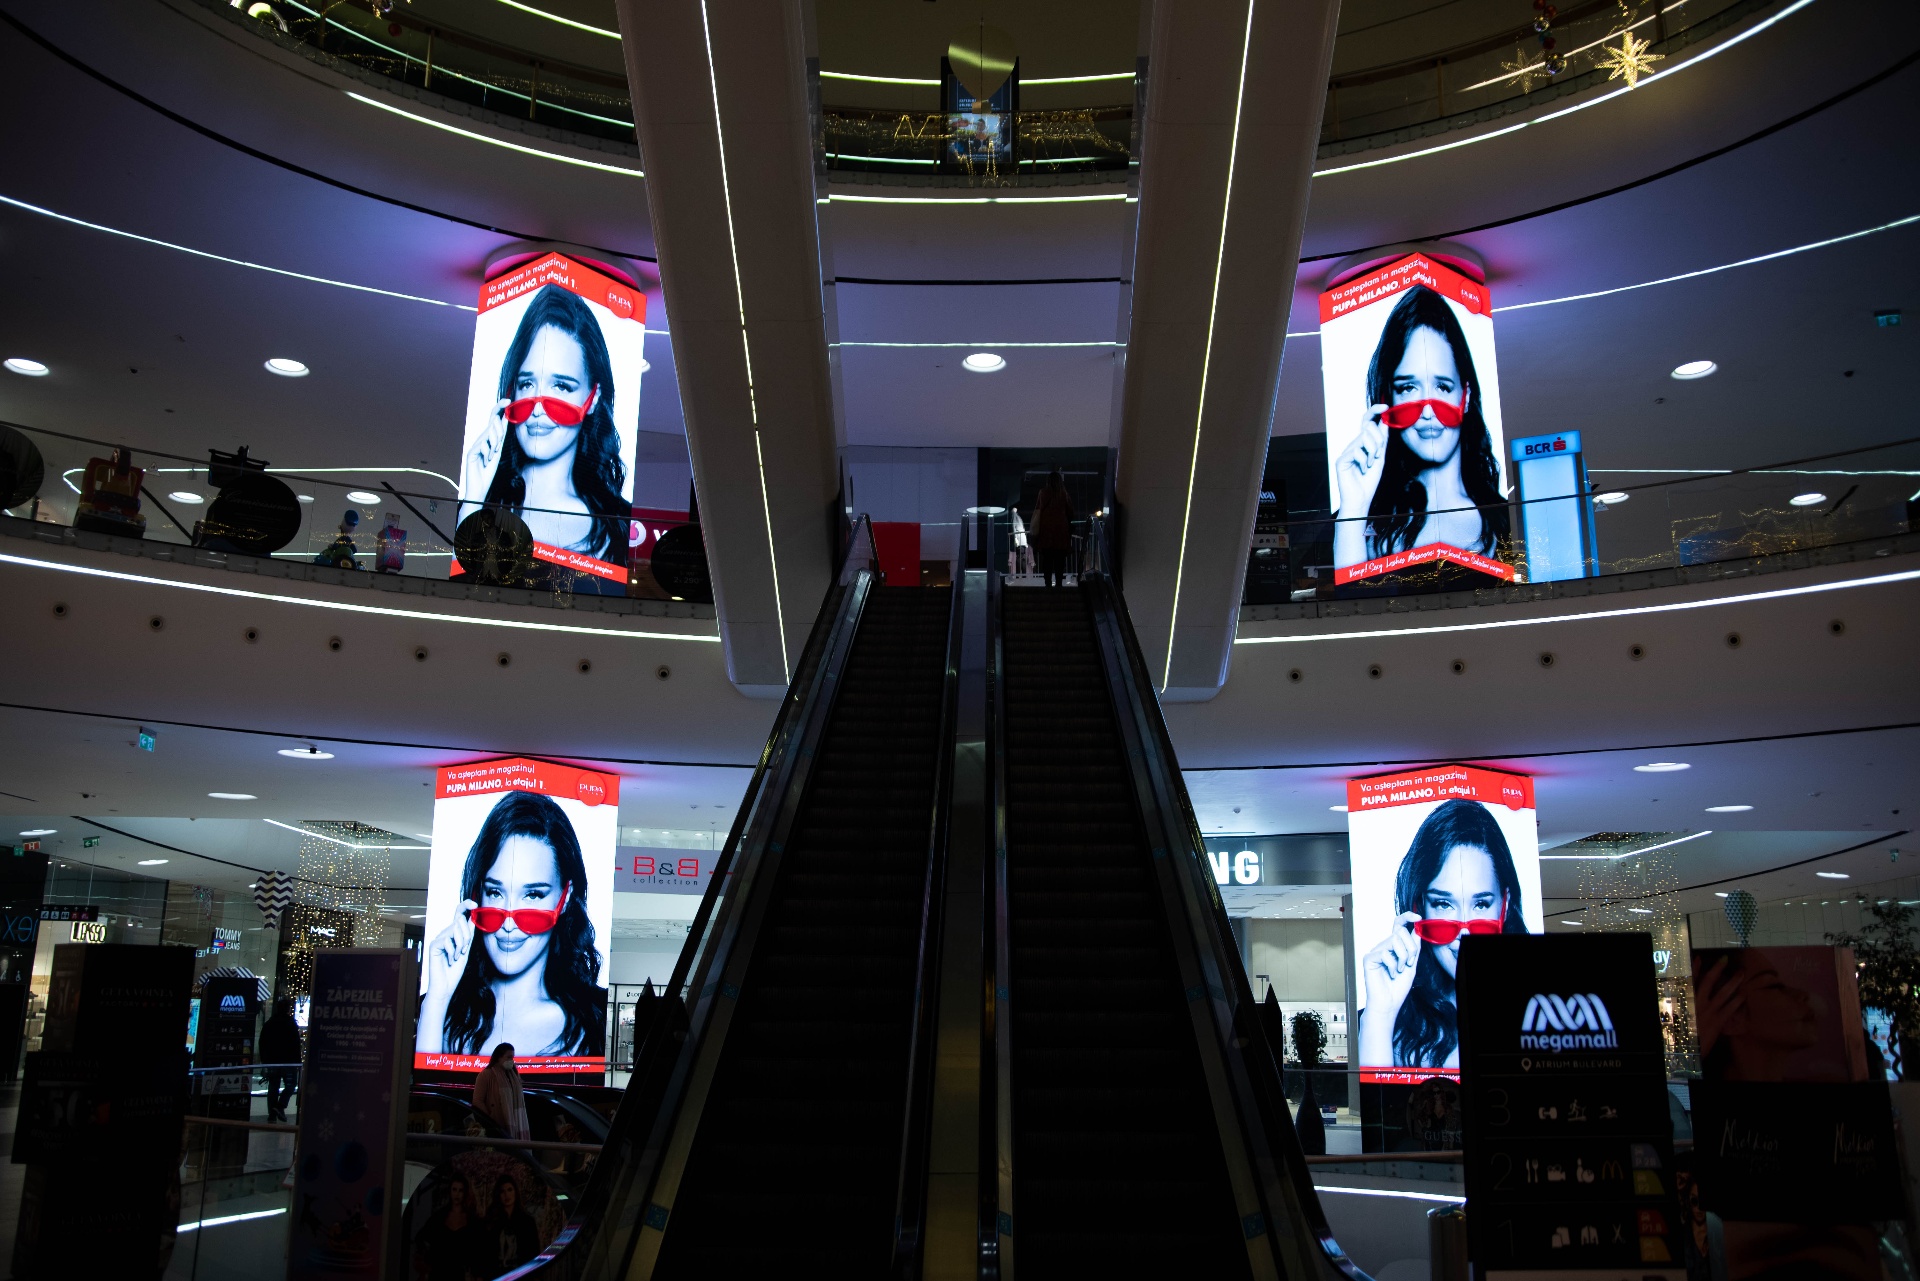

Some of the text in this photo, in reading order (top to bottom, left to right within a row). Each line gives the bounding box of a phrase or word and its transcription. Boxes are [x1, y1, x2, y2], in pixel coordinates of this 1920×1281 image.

[532, 257, 568, 274] magazinul
[1331, 291, 1343, 301] Va
[1381, 272, 1389, 281] in
[1390, 258, 1429, 276] magazinul
[486, 292, 506, 307] PUPA
[506, 278, 538, 297] MILANO,
[546, 270, 569, 285] etajul
[1332, 298, 1358, 315] PUPA
[1358, 280, 1401, 305] MILANO,
[1402, 275, 1411, 285] la
[608, 292, 632, 309] PUPA
[1525, 442, 1551, 455] BCR
[447, 771, 456, 780] Va
[488, 767, 495, 775] in
[496, 764, 535, 774] magazinul
[446, 782, 468, 793] PUPA
[468, 779, 503, 792] MILANO,
[505, 777, 512, 787] la
[512, 777, 537, 789] etajul
[579, 783, 604, 794] PUPA
[1360, 783, 1372, 792] Va
[1414, 776, 1423, 785] in
[1425, 770, 1468, 783] magazinul
[1361, 794, 1388, 806] PUPA
[1390, 787, 1436, 802] MILANO,
[1438, 785, 1446, 795] la
[1448, 784, 1470, 796] etajul
[1502, 787, 1523, 797] PUPA
[633, 856, 699, 877] B&B
[1207, 850, 1260, 885] NG
[632, 876, 698, 886] collection
[215, 927, 242, 941] TOMMY
[224, 941, 241, 950] JEANS
[1653, 950, 1670, 973] ay
[326, 986, 384, 1003] ZĂPEZILE
[314, 1003, 394, 1021] DE ALTĂDATĂ
[1519, 1029, 1620, 1053] megamall
[1535, 1059, 1622, 1069] ATRIUM BULEVARD
[1486, 1087, 1512, 1127] 3
[1489, 1152, 1515, 1191] 2
